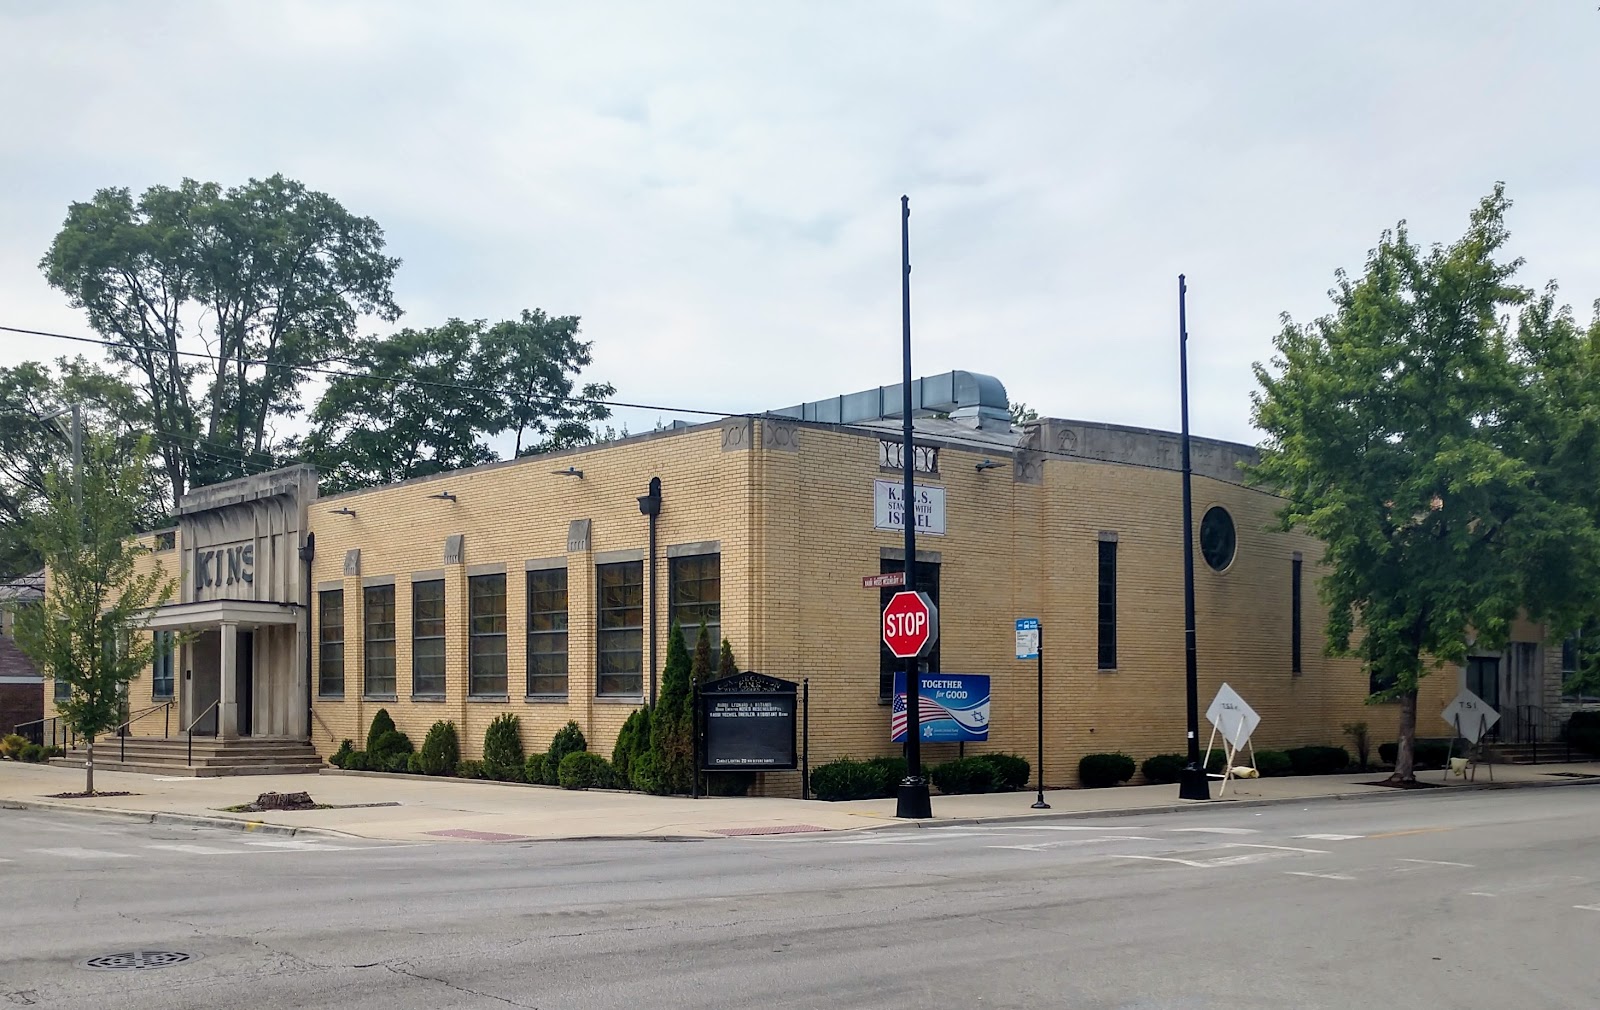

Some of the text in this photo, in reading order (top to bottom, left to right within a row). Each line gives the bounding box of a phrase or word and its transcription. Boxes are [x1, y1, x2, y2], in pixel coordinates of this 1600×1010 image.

[888, 487, 932, 504] K.I.S.
[915, 504, 932, 514] WITH
[888, 511, 932, 528] ISEL
[195, 544, 254, 590] KINS
[886, 611, 926, 638] STOP
[921, 679, 963, 689] TOGETHER
[935, 690, 968, 699] for GOOD
